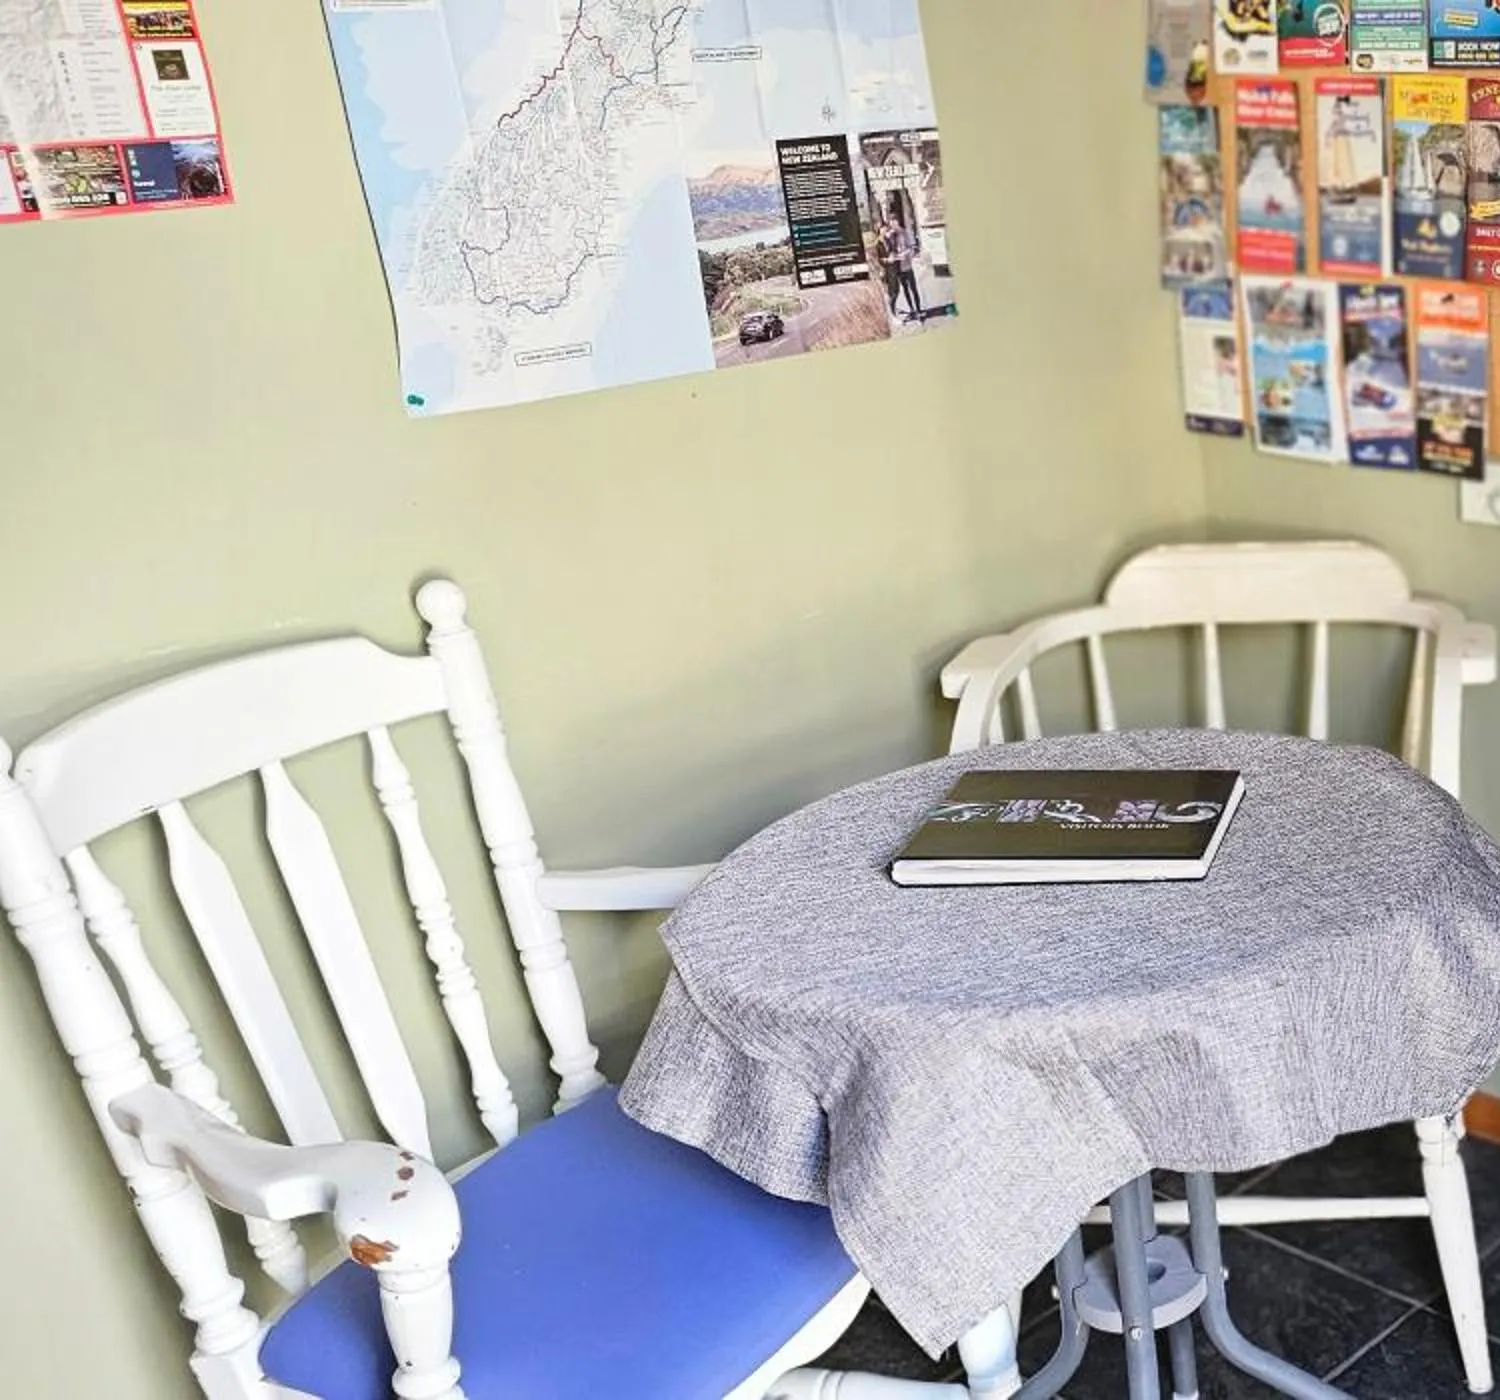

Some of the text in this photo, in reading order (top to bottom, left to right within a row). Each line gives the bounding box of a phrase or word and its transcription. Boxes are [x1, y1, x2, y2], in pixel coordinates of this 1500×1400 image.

[780, 144, 820, 155] WELCOME
[781, 151, 839, 164] NEW ZEALAND
